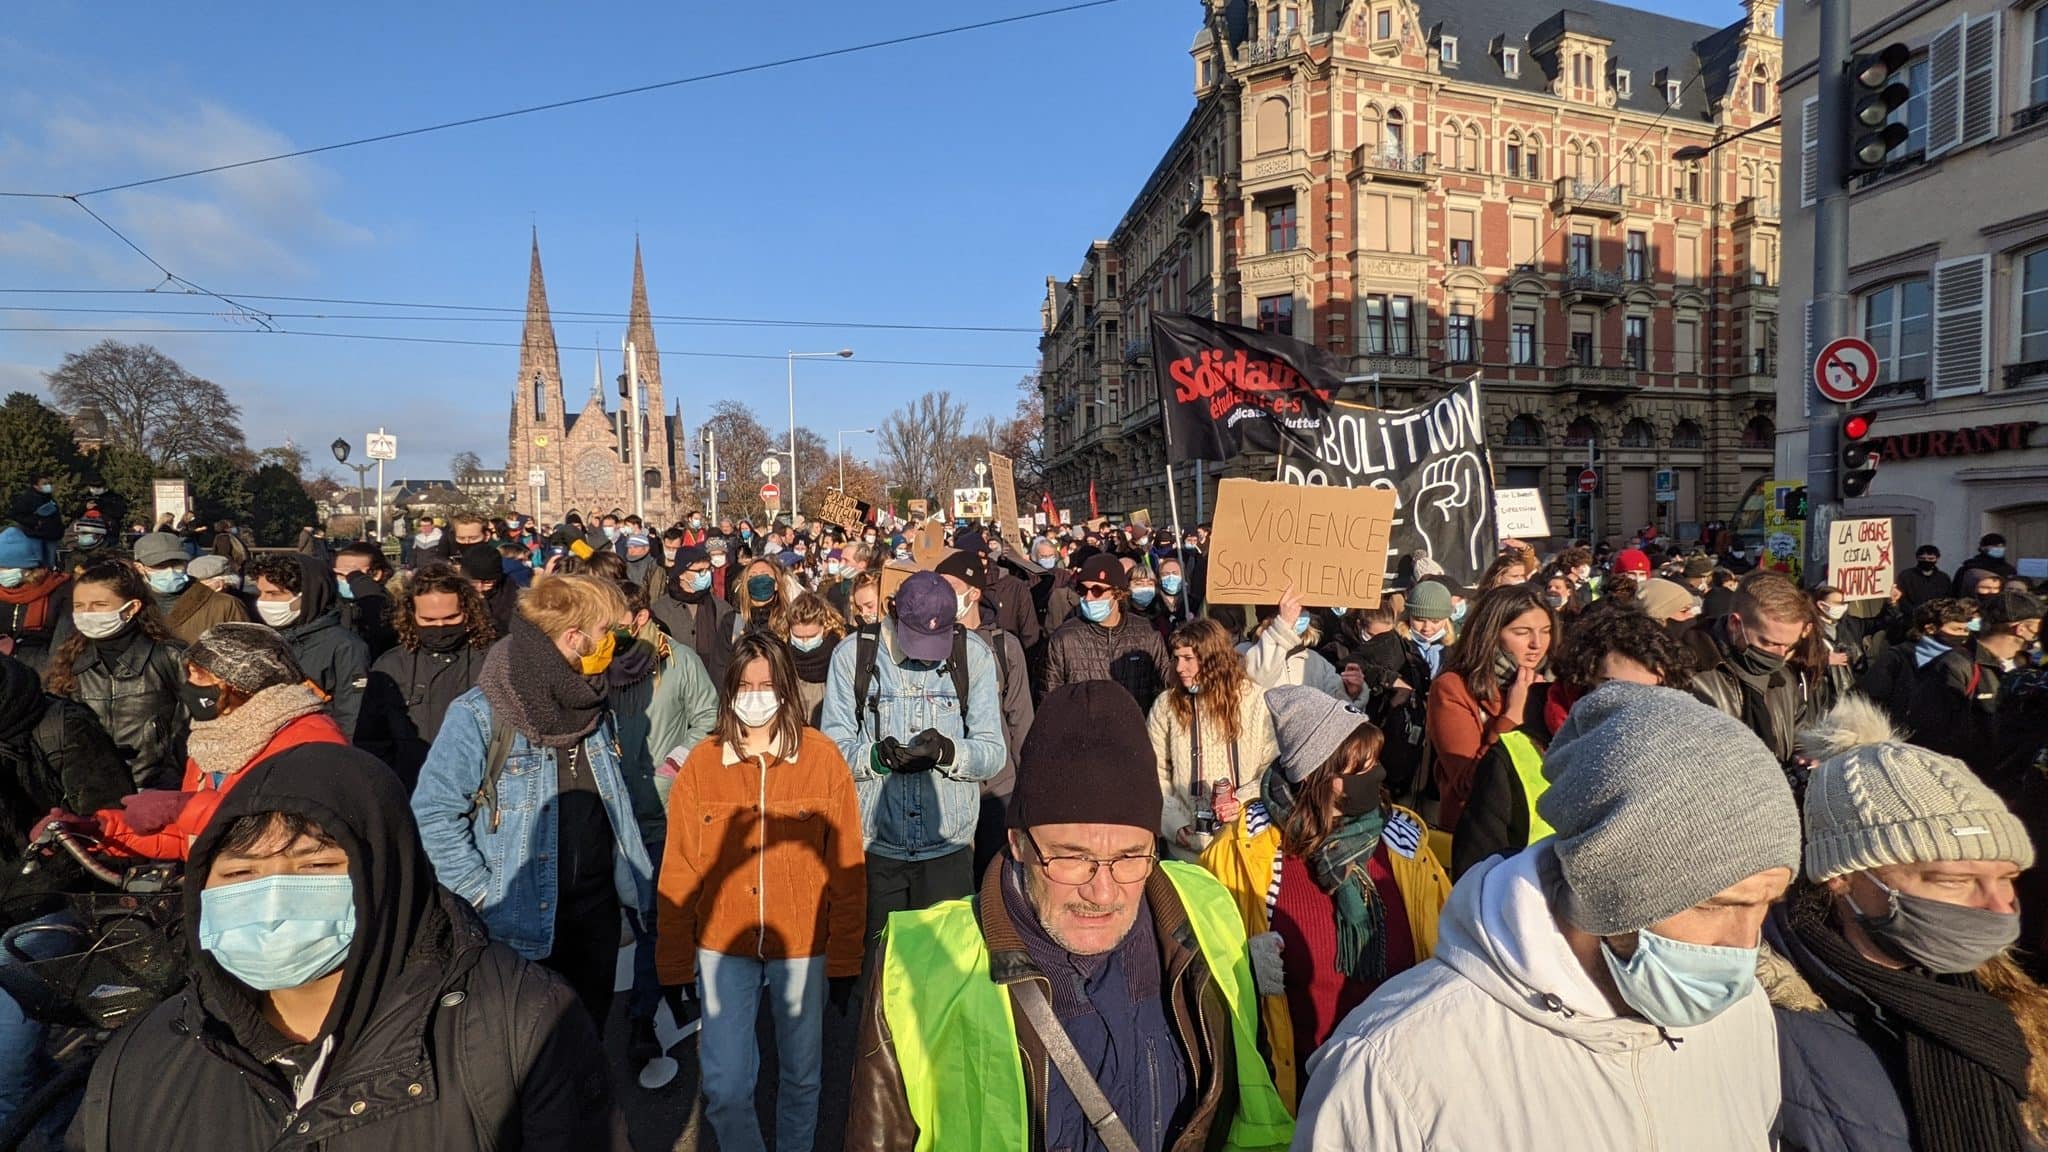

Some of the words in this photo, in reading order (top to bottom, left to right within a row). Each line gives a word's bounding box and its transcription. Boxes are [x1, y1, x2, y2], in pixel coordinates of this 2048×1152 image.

[1241, 496, 1390, 552] VIOLENCE
[1838, 524, 1853, 545] LA
[1860, 547, 1871, 562] LA
[1278, 557, 1382, 599] SILENCE
